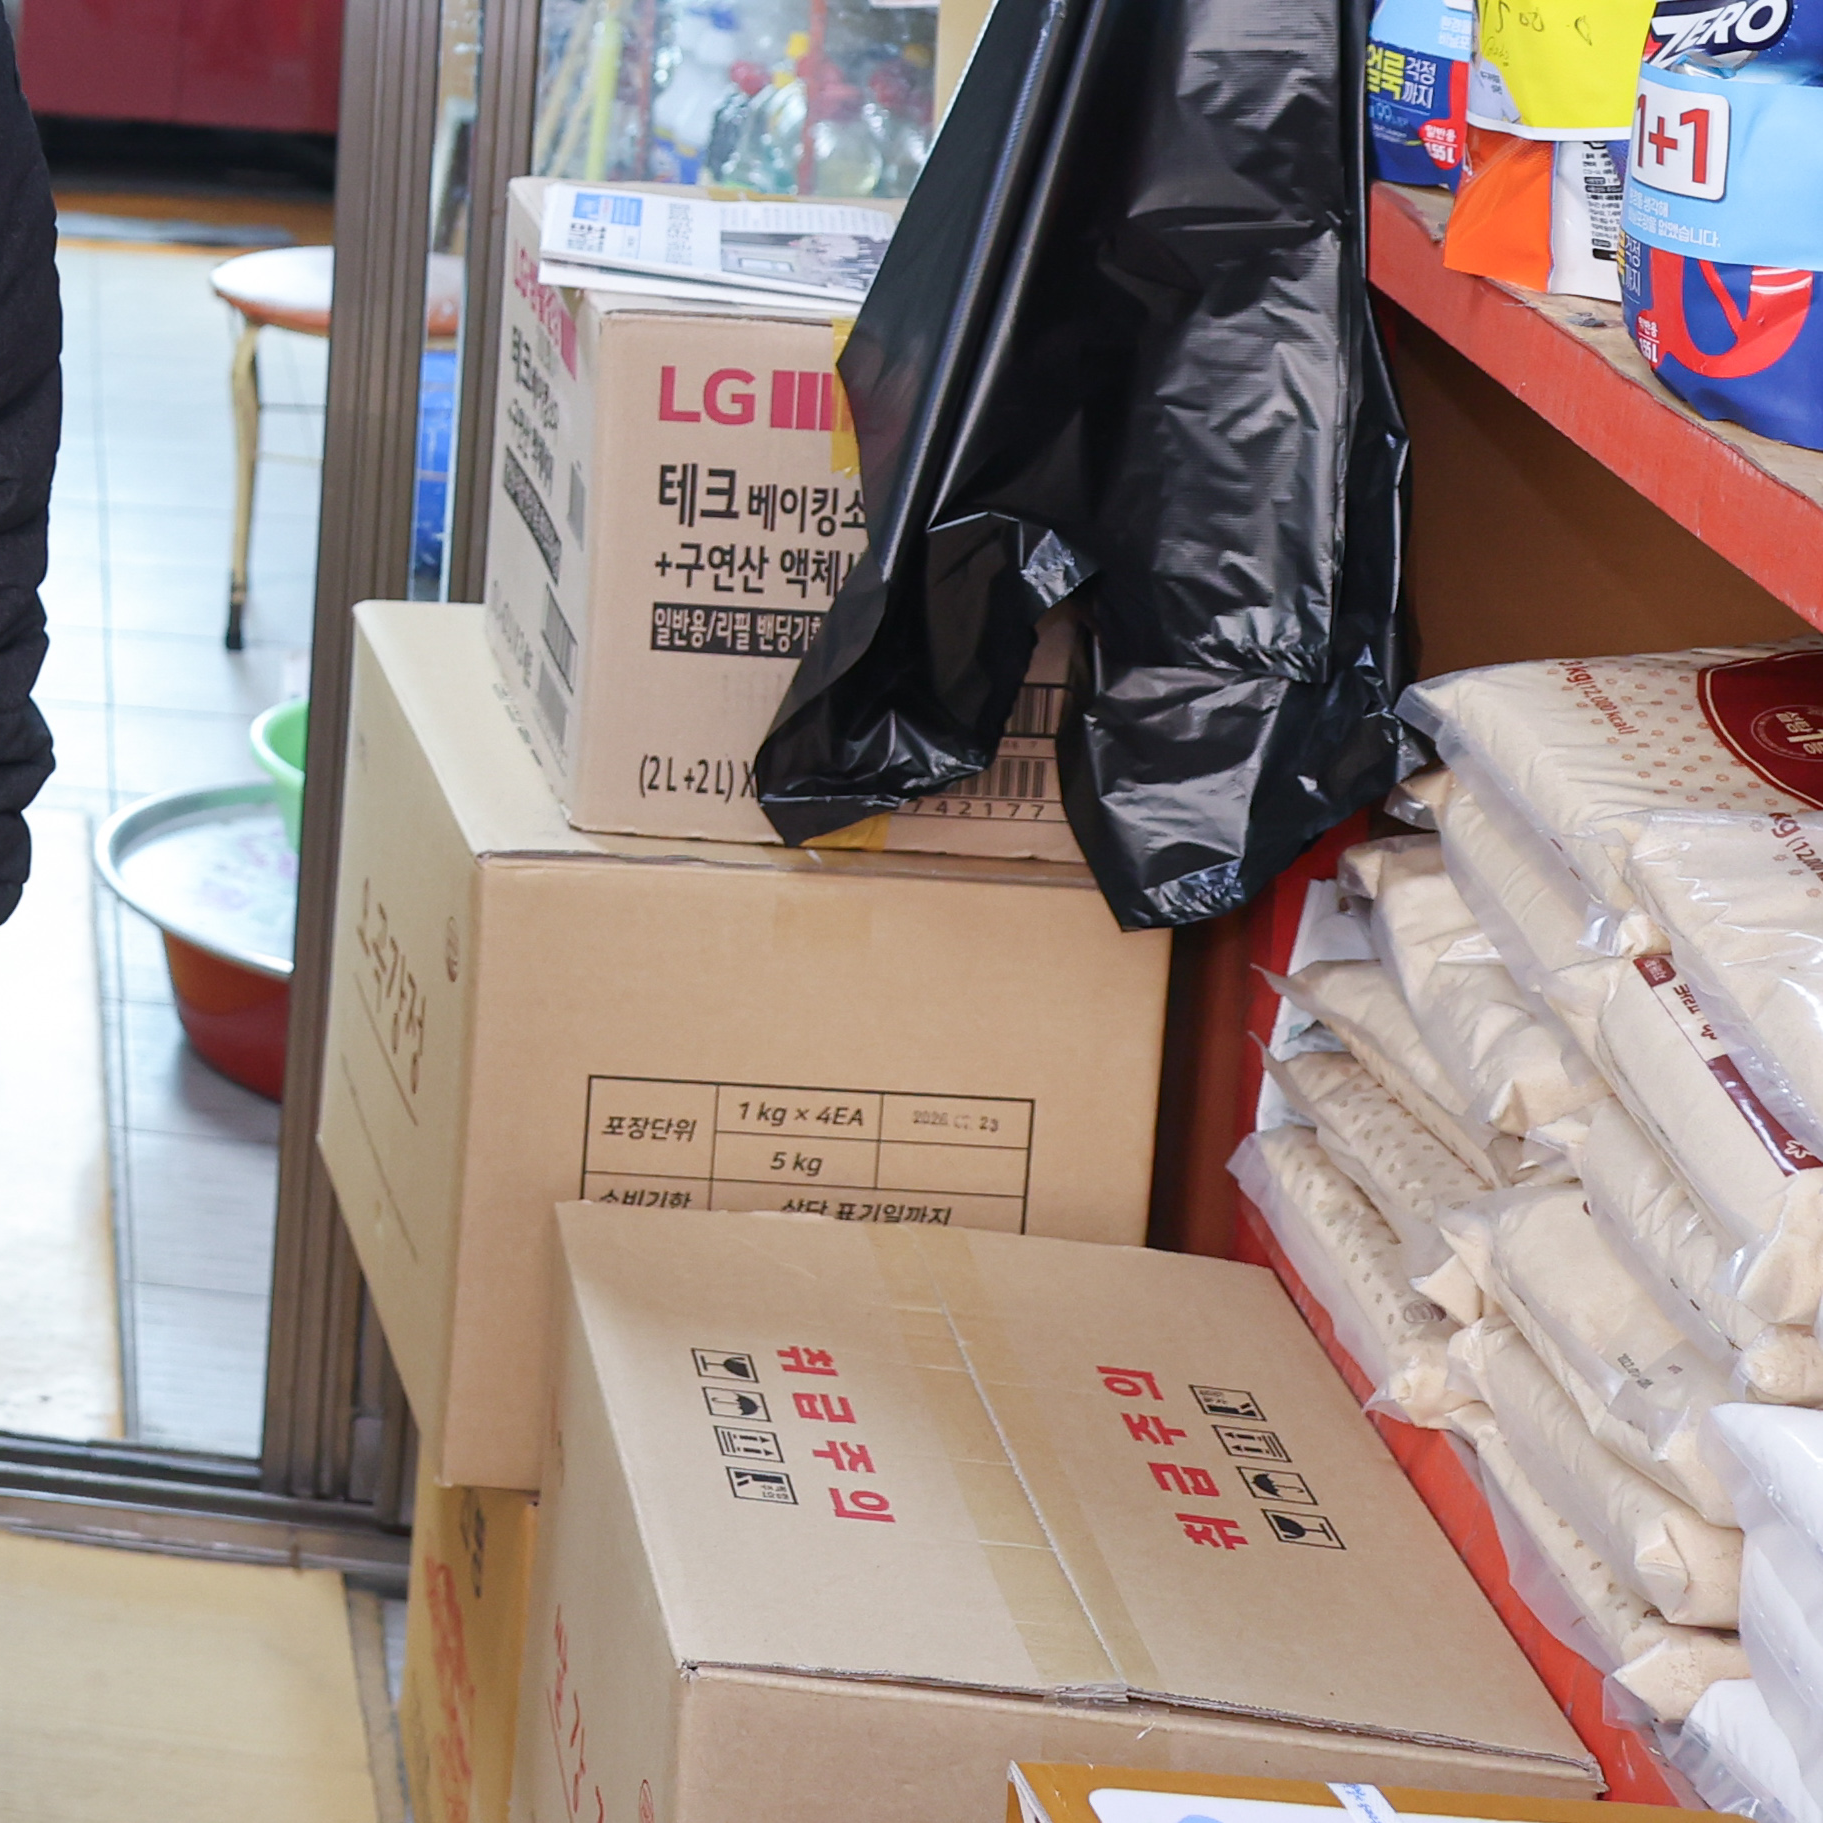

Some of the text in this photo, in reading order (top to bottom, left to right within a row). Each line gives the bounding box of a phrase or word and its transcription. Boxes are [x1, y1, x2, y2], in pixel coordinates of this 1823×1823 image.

[1405, 56, 1438, 82] 걱정
[1403, 80, 1435, 110] 까지
[1634, 93, 1711, 185] 1+1
[658, 364, 757, 426] LG
[658, 462, 867, 537] 테크 베이킹소
[655, 542, 770, 594] +구연산
[653, 605, 752, 653] 일반용/리필
[602, 1113, 697, 1143] 포장단위
[739, 1101, 749, 1121] 1
[757, 1102, 787, 1128] kg
[819, 1105, 865, 1127] 4EA
[770, 1151, 823, 1177] 5 kg
[836, 1200, 953, 1227] 표기일까지
[777, 1344, 896, 1523] 취급주의
[1096, 1365, 1249, 1551] 취급주의
